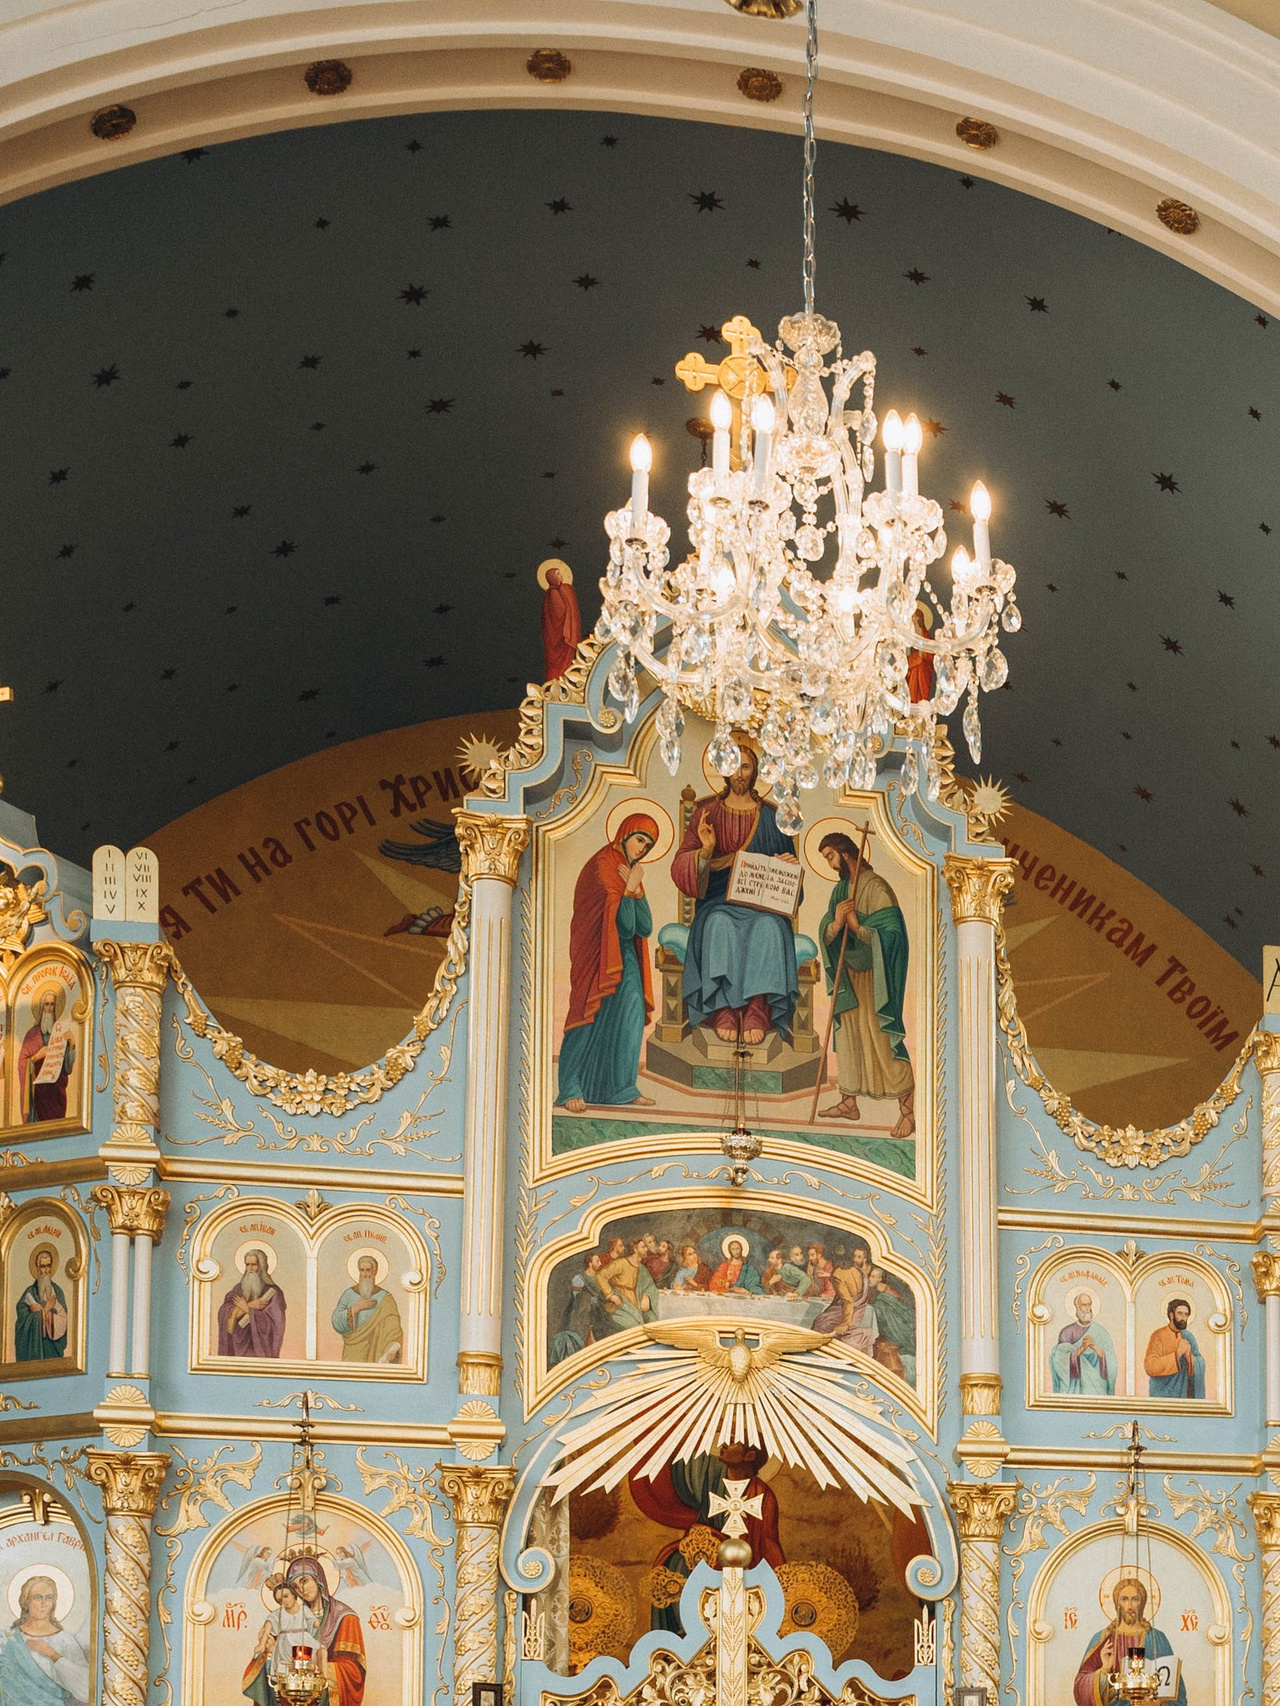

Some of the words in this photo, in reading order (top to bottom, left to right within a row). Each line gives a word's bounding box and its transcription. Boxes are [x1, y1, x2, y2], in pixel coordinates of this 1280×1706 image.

[135, 851, 148, 860] VI
[105, 863, 114, 872] II
[134, 863, 150, 872] VII
[104, 876, 116, 885] III
[132, 873, 152, 883] VIII
[103, 890, 117, 900] IV
[135, 888, 148, 898] IX
[105, 904, 116, 914] V
[137, 901, 146, 911] X
